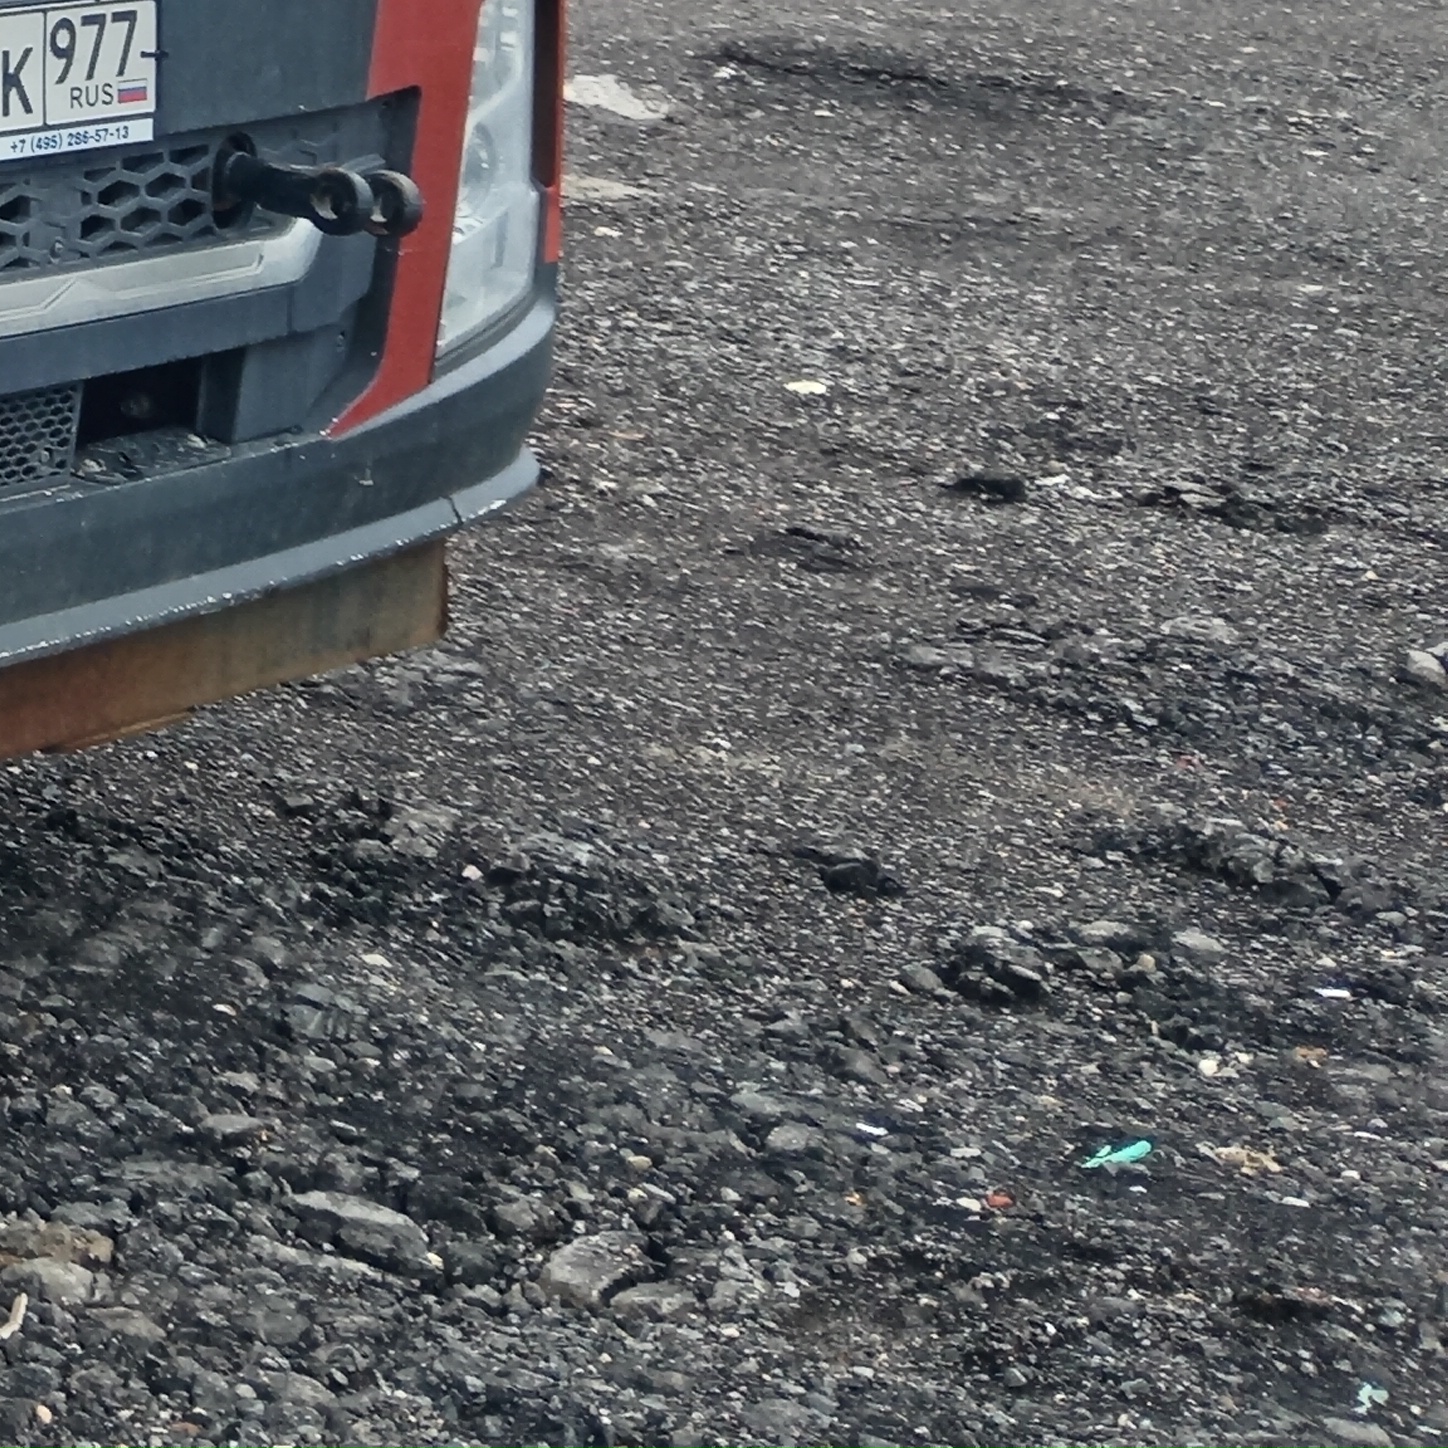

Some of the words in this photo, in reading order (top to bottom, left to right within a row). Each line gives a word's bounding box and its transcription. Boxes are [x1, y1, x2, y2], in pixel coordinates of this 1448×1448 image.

[50, 10, 138, 85] 977
[70, 82, 114, 109] RUS
[10, 138, 26, 153] +7
[30, 132, 63, 153] (495)
